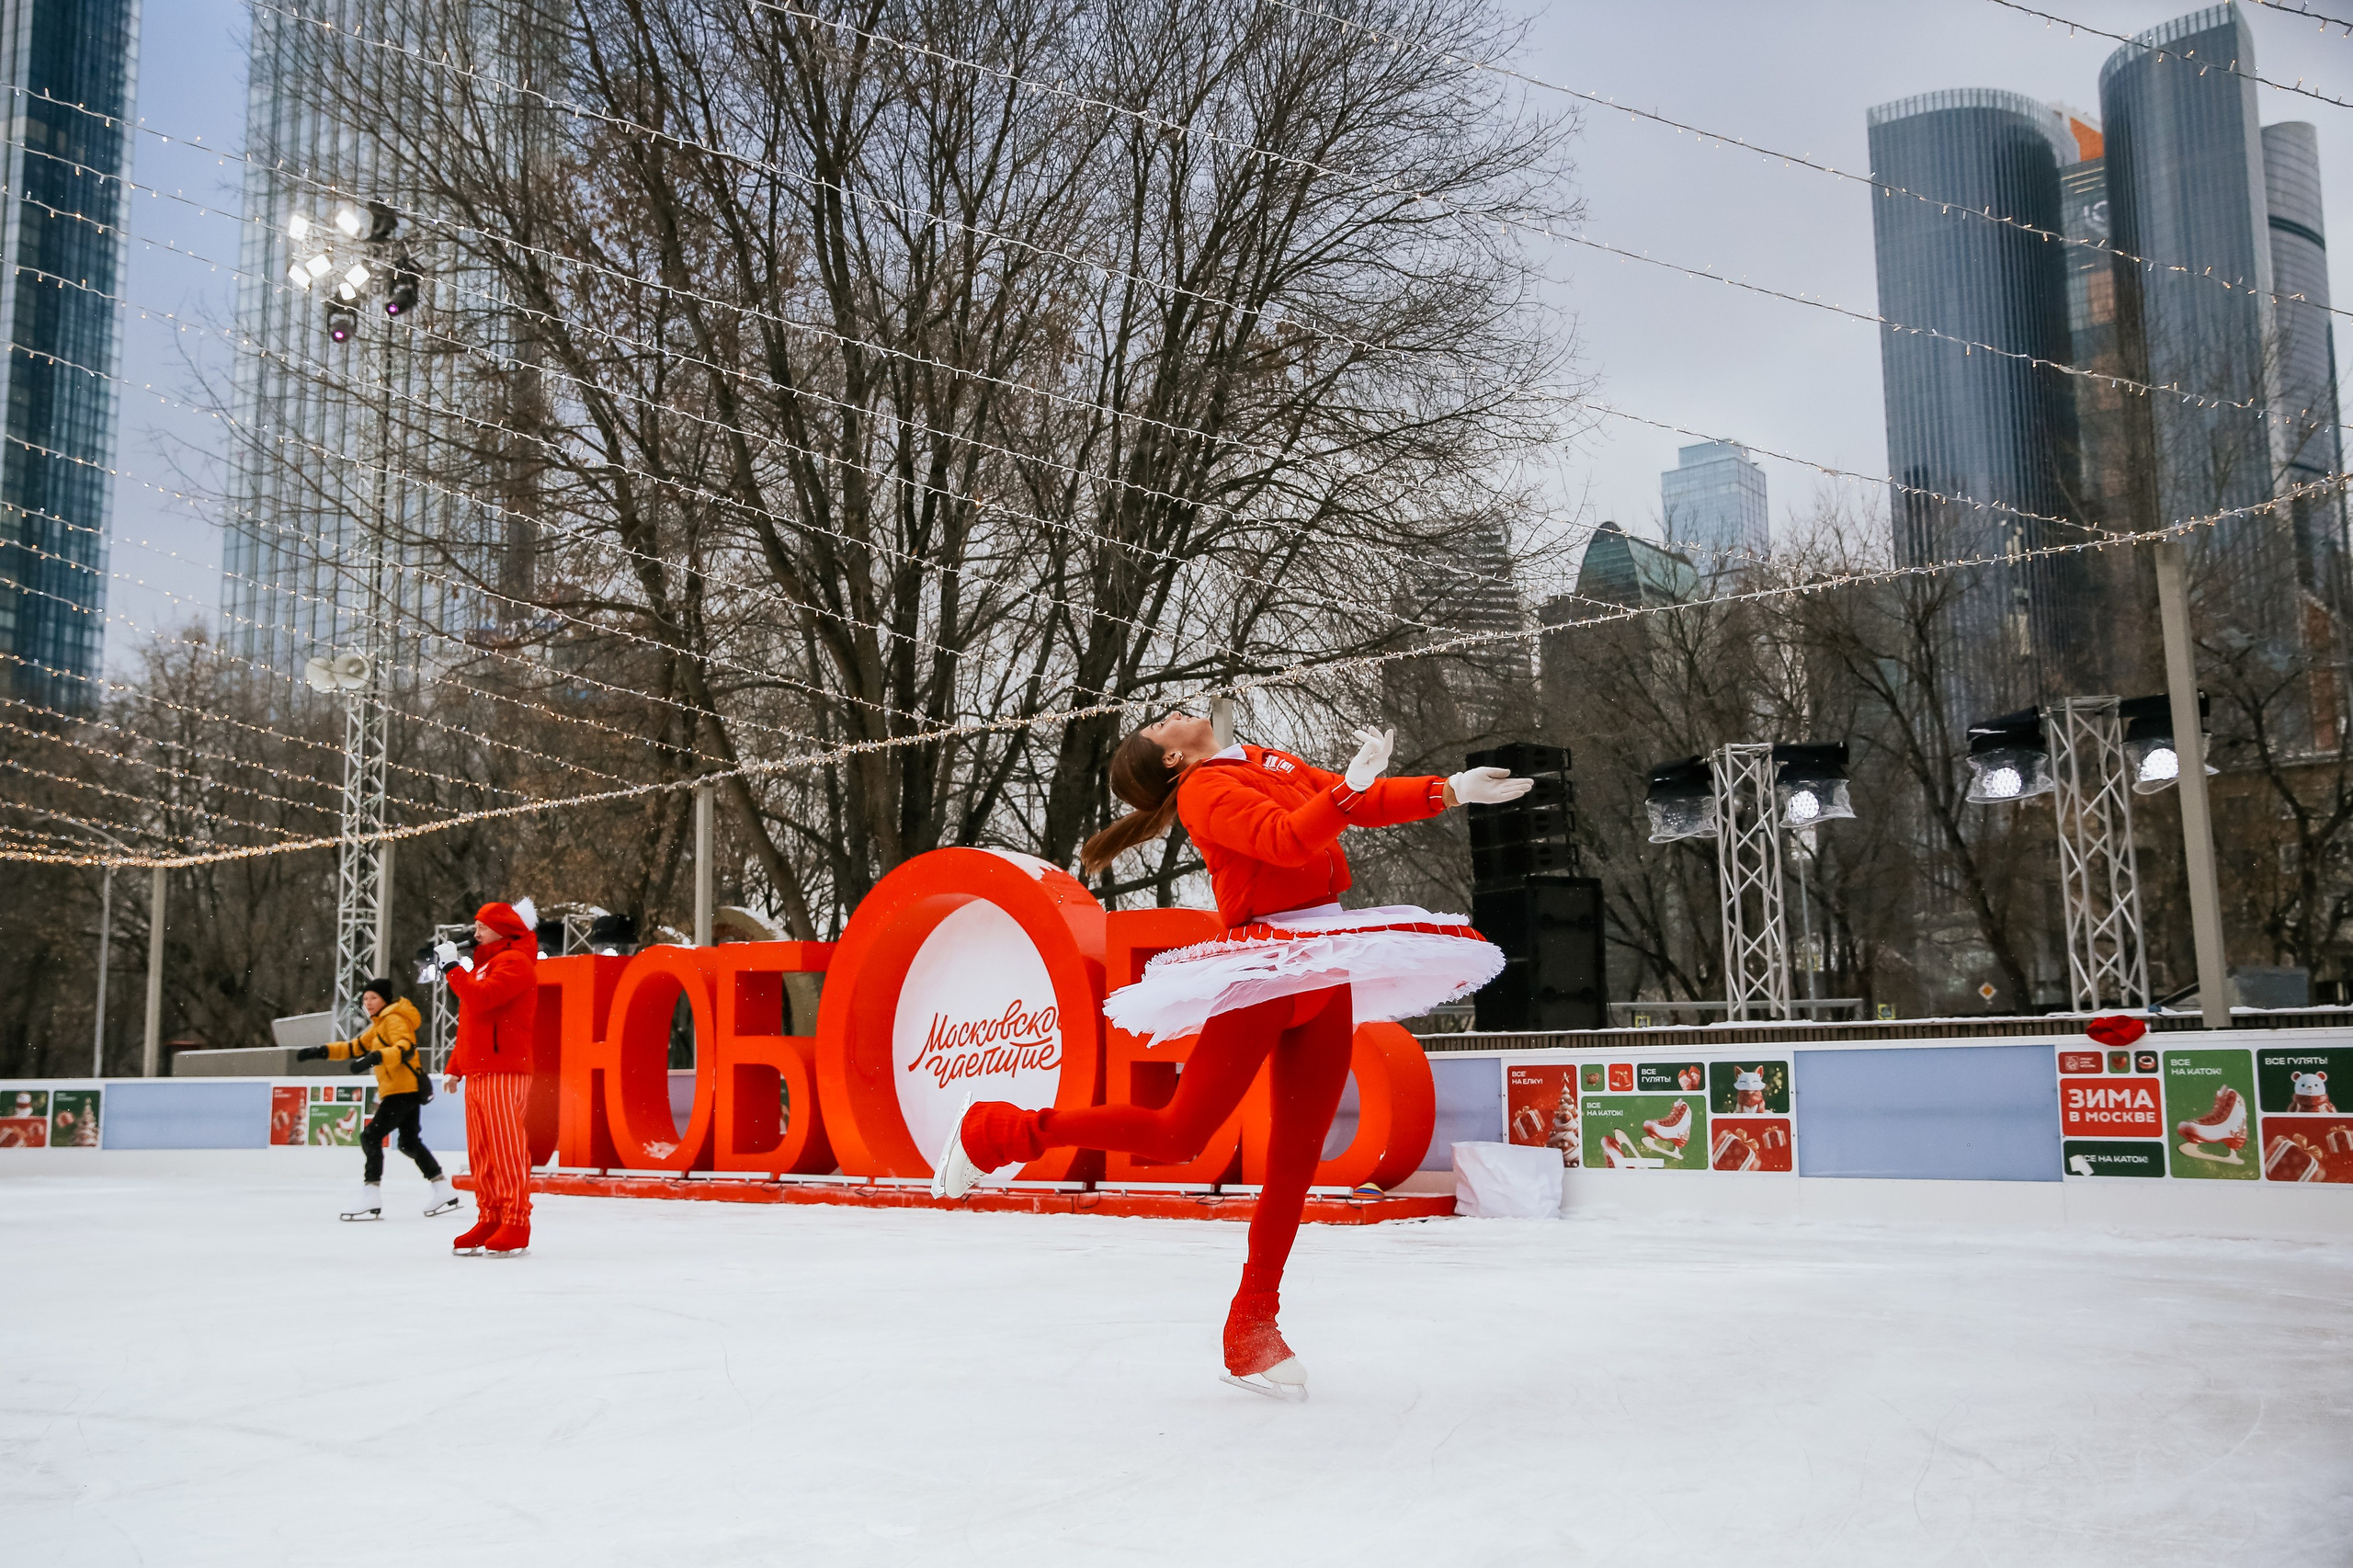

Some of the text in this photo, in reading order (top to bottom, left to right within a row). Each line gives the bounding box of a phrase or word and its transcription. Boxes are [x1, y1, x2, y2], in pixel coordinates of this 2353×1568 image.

[907, 999, 1061, 1072] Московско
[925, 1035, 1063, 1088] чаепитие
[2287, 1057, 2328, 1065] ГУЛЯТЬ!
[2067, 1088, 2155, 1108] ЗИМА
[2068, 1111, 2156, 1123] В МОСКВЕ
[2084, 1154, 2097, 1163] СЕ
[2113, 1155, 2149, 1164] КАТОК!
